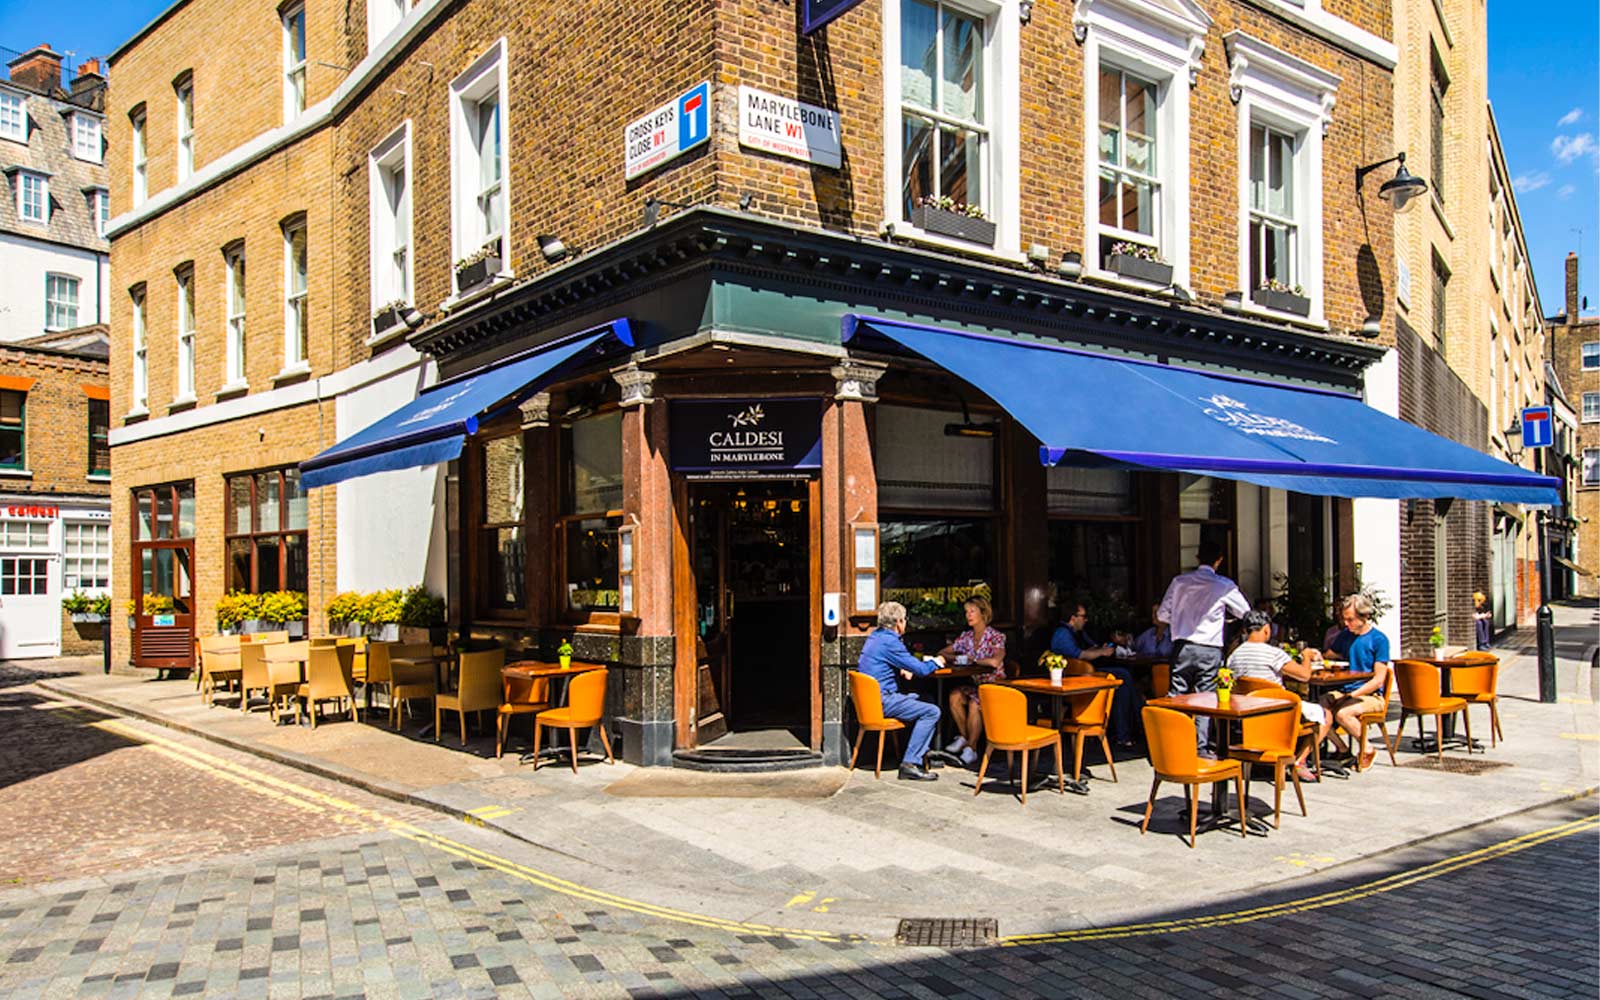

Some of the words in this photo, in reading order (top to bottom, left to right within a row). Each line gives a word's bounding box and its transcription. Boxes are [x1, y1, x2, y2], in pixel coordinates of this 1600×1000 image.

[628, 119, 653, 143] CROSS
[655, 106, 674, 129] KEYS
[747, 93, 833, 131] MARYLEBONE
[748, 112, 781, 134] LANE
[785, 121, 803, 140] W1
[628, 136, 651, 160] CLOSE
[653, 129, 665, 148] W1
[709, 431, 784, 447] CALDESI
[710, 453, 722, 462] IN
[723, 452, 785, 462] MARYLEBONE
